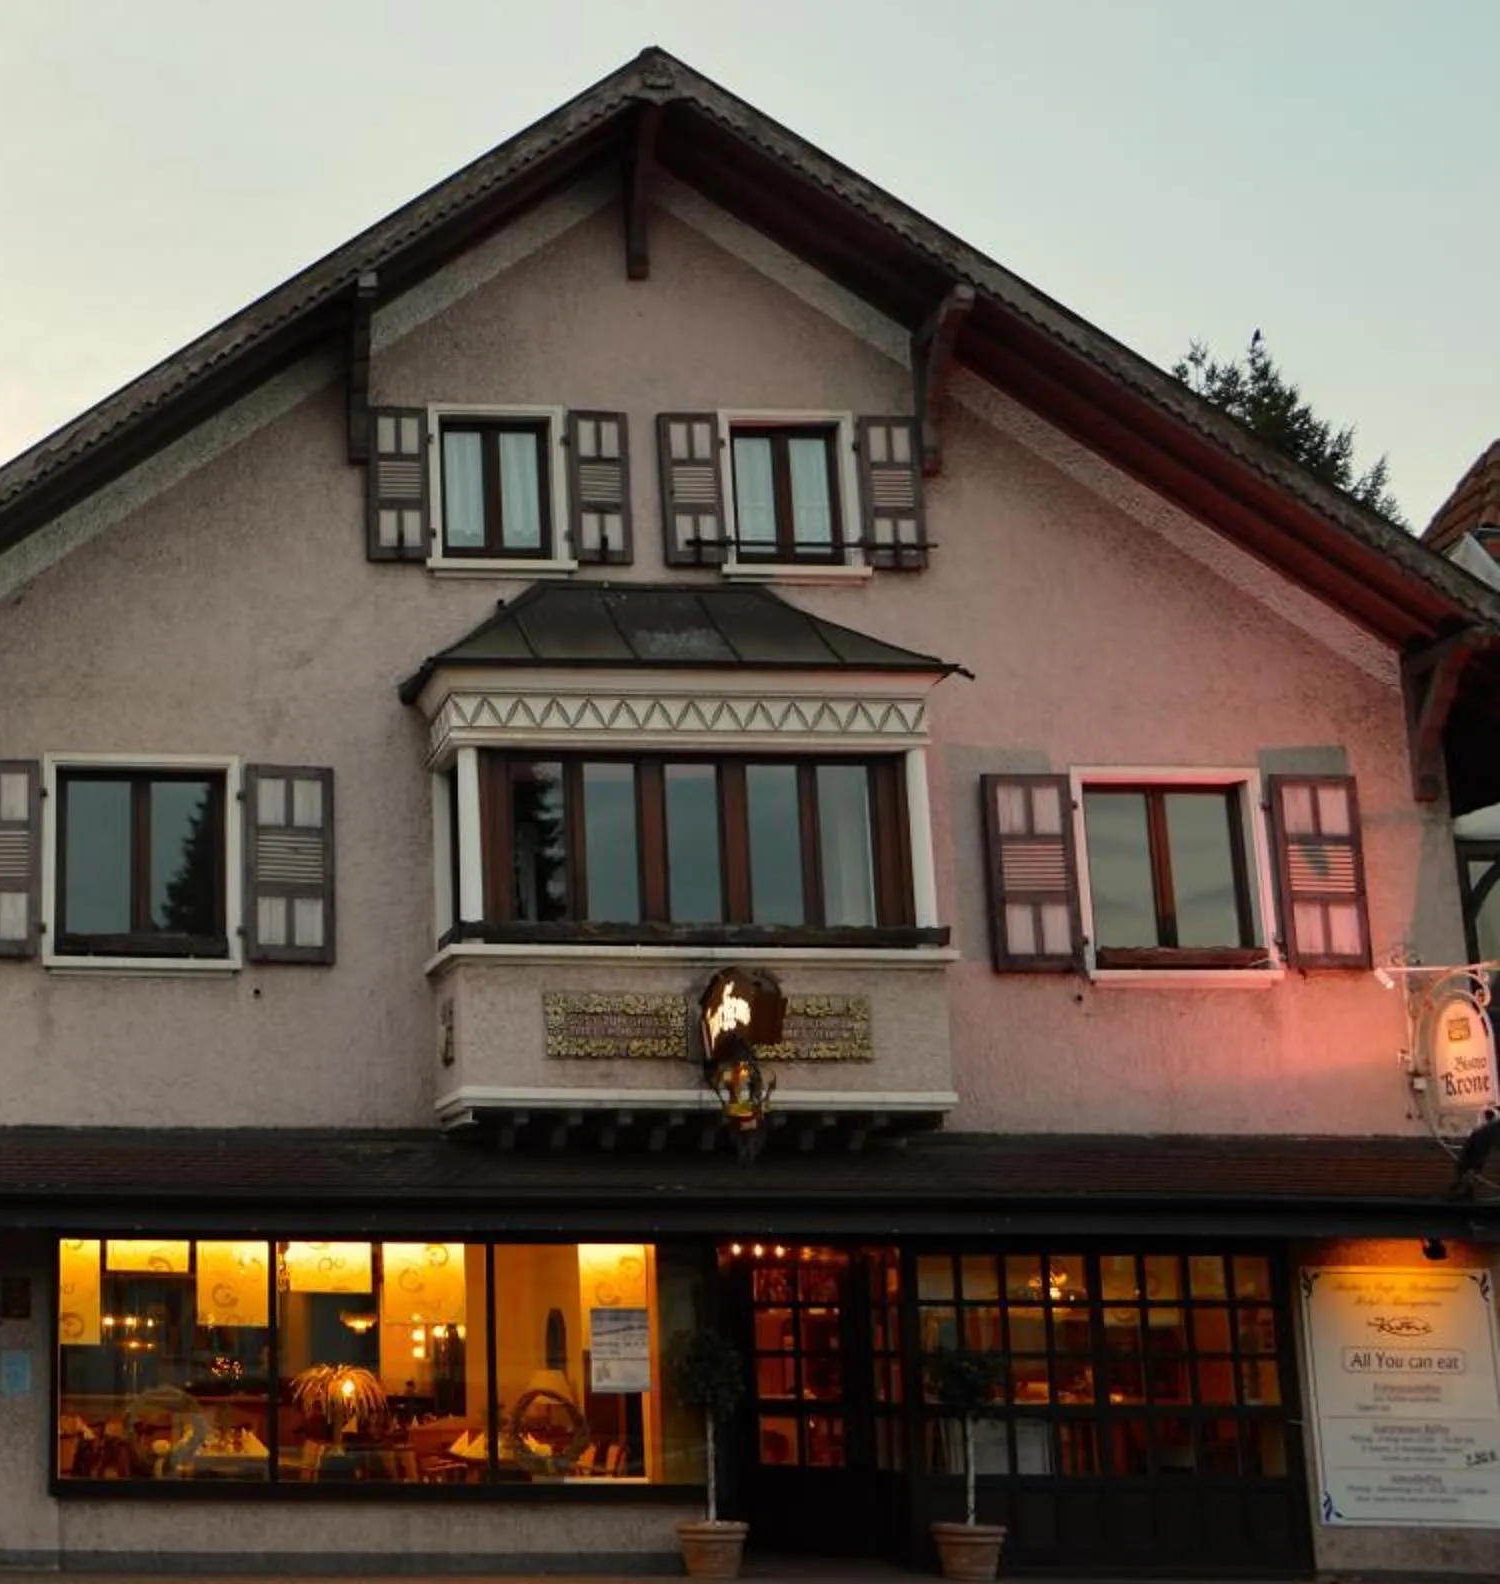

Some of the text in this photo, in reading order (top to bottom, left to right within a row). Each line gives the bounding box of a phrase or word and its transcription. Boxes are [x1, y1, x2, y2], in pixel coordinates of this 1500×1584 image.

[1439, 1070, 1490, 1097] Krone
[1350, 1351, 1460, 1370] All You can eat
